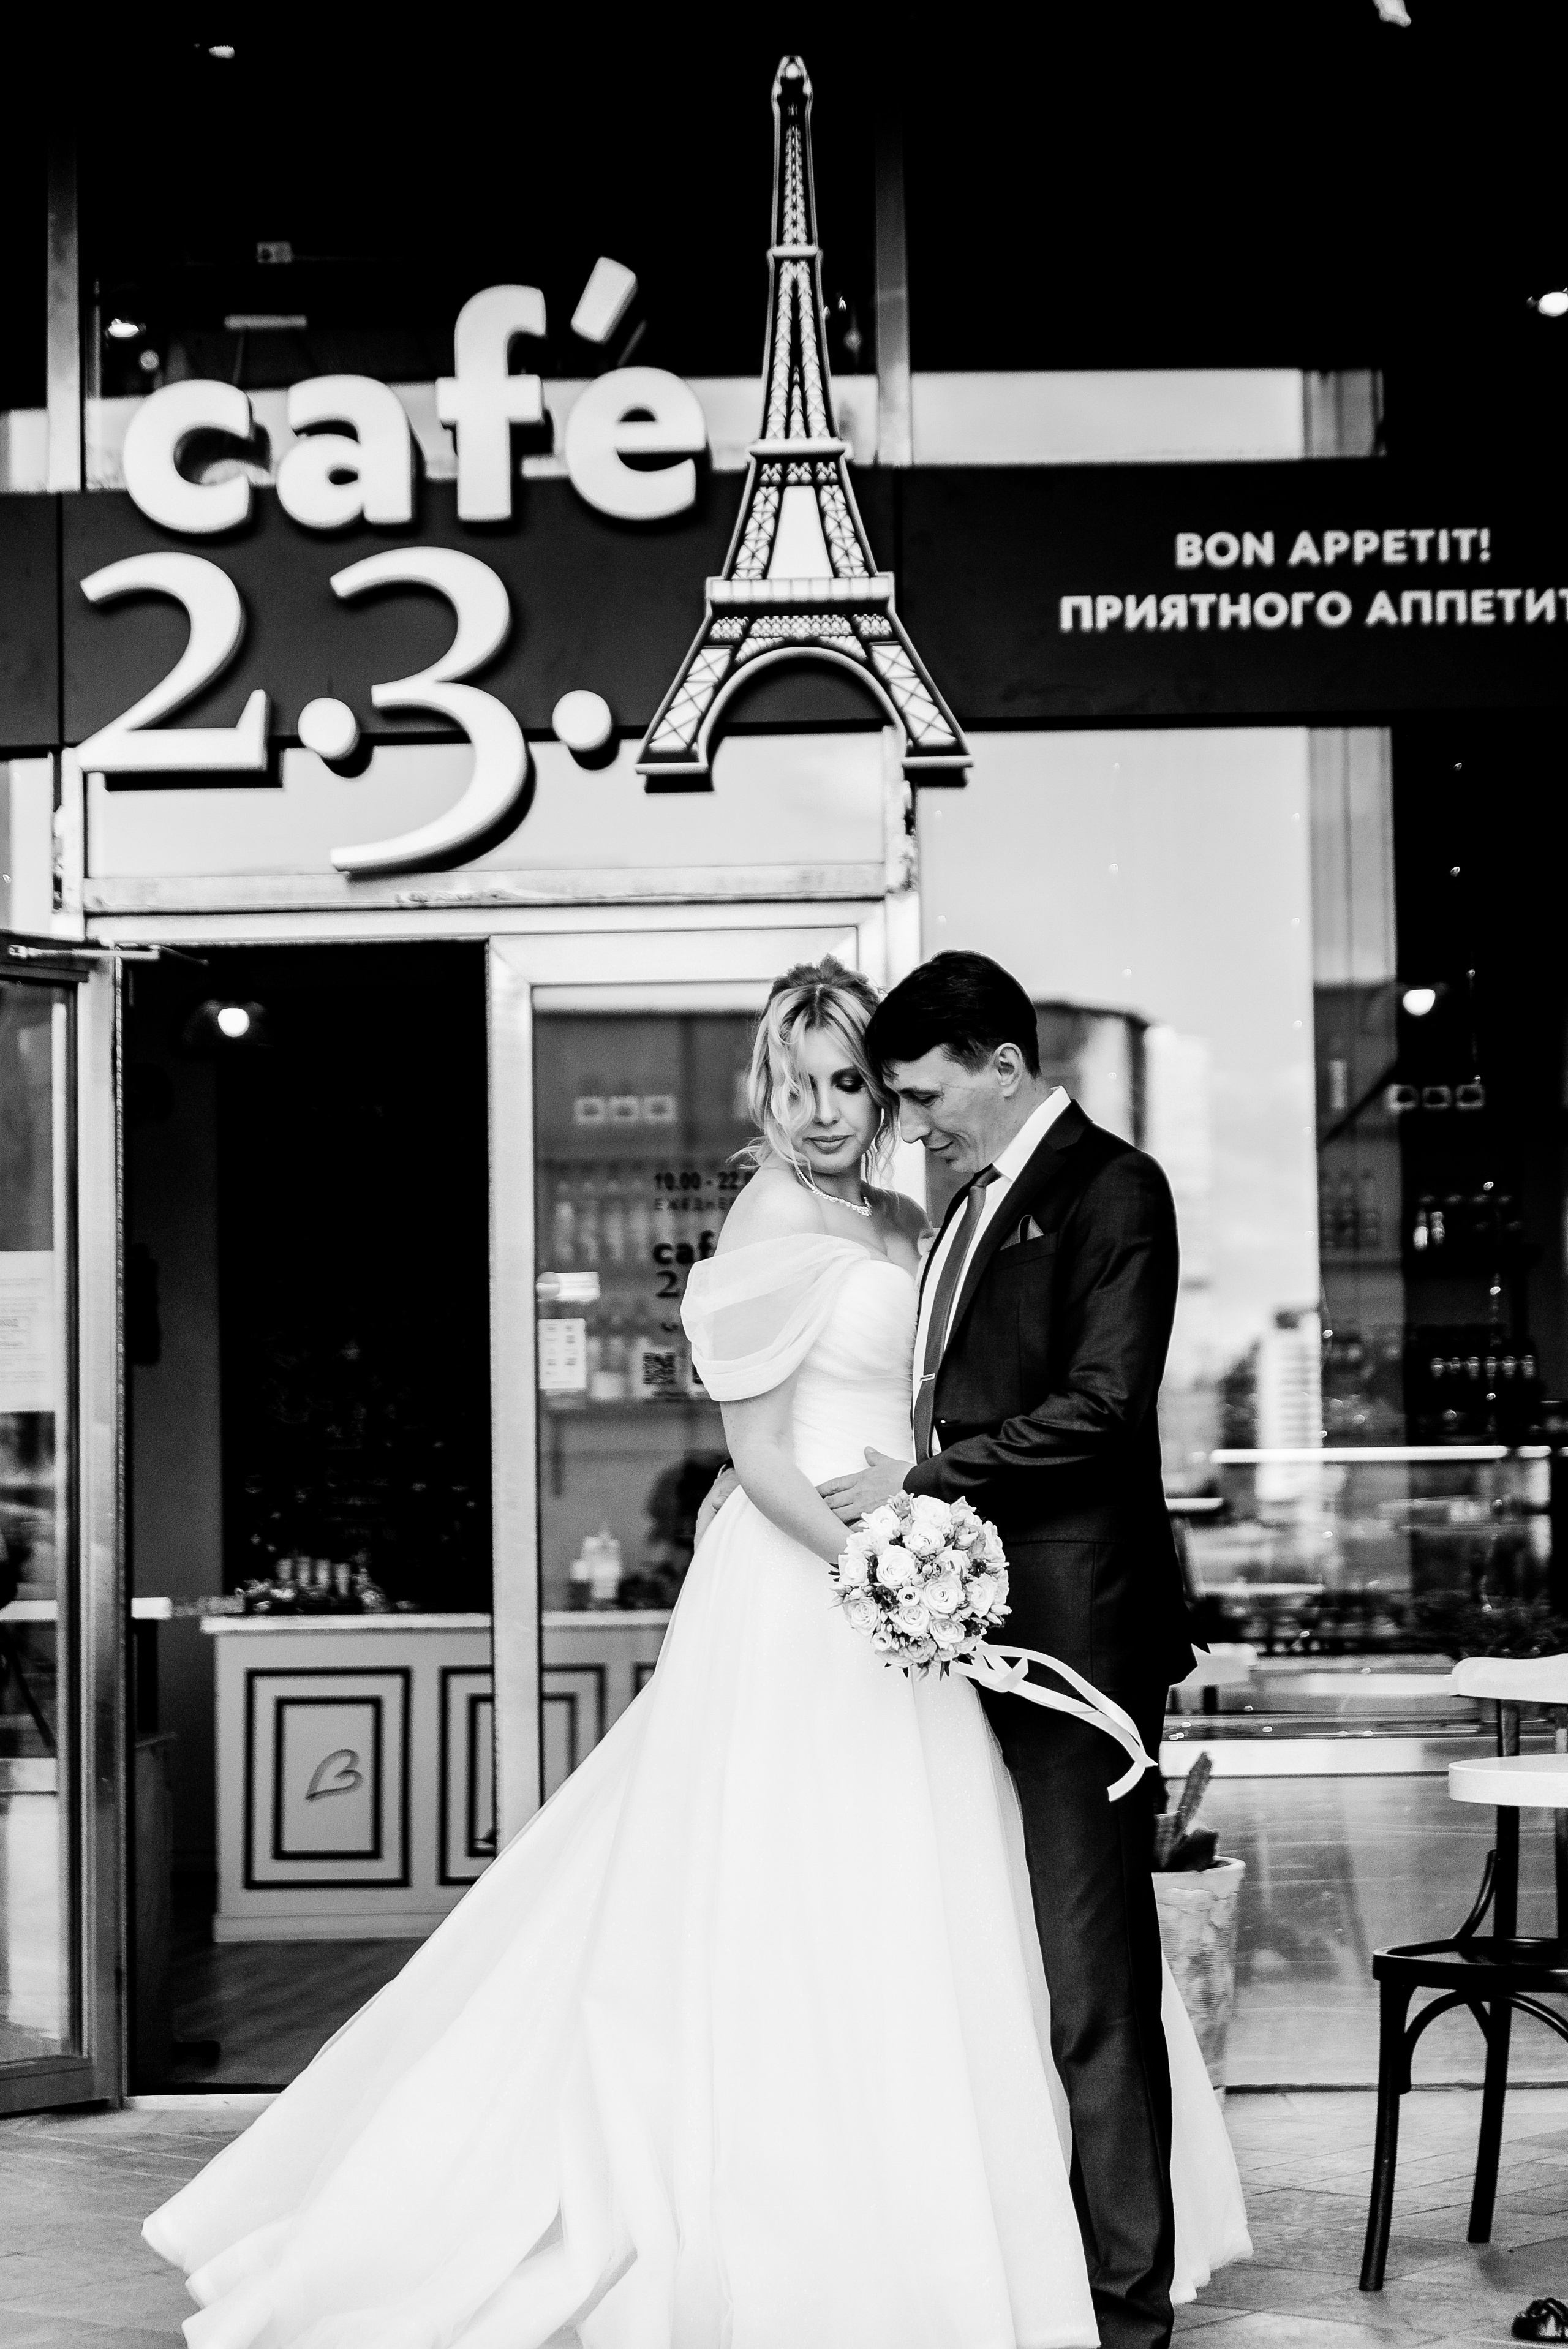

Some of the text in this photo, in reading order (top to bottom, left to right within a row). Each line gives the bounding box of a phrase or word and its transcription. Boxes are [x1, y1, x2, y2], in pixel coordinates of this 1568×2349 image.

[123, 256, 707, 534] café
[1175, 527, 1491, 568] BON APPETIT!
[1059, 590, 1353, 633] ПРИЯТНОГО
[78, 546, 612, 872] 2.3.
[653, 1229, 715, 1265] caf
